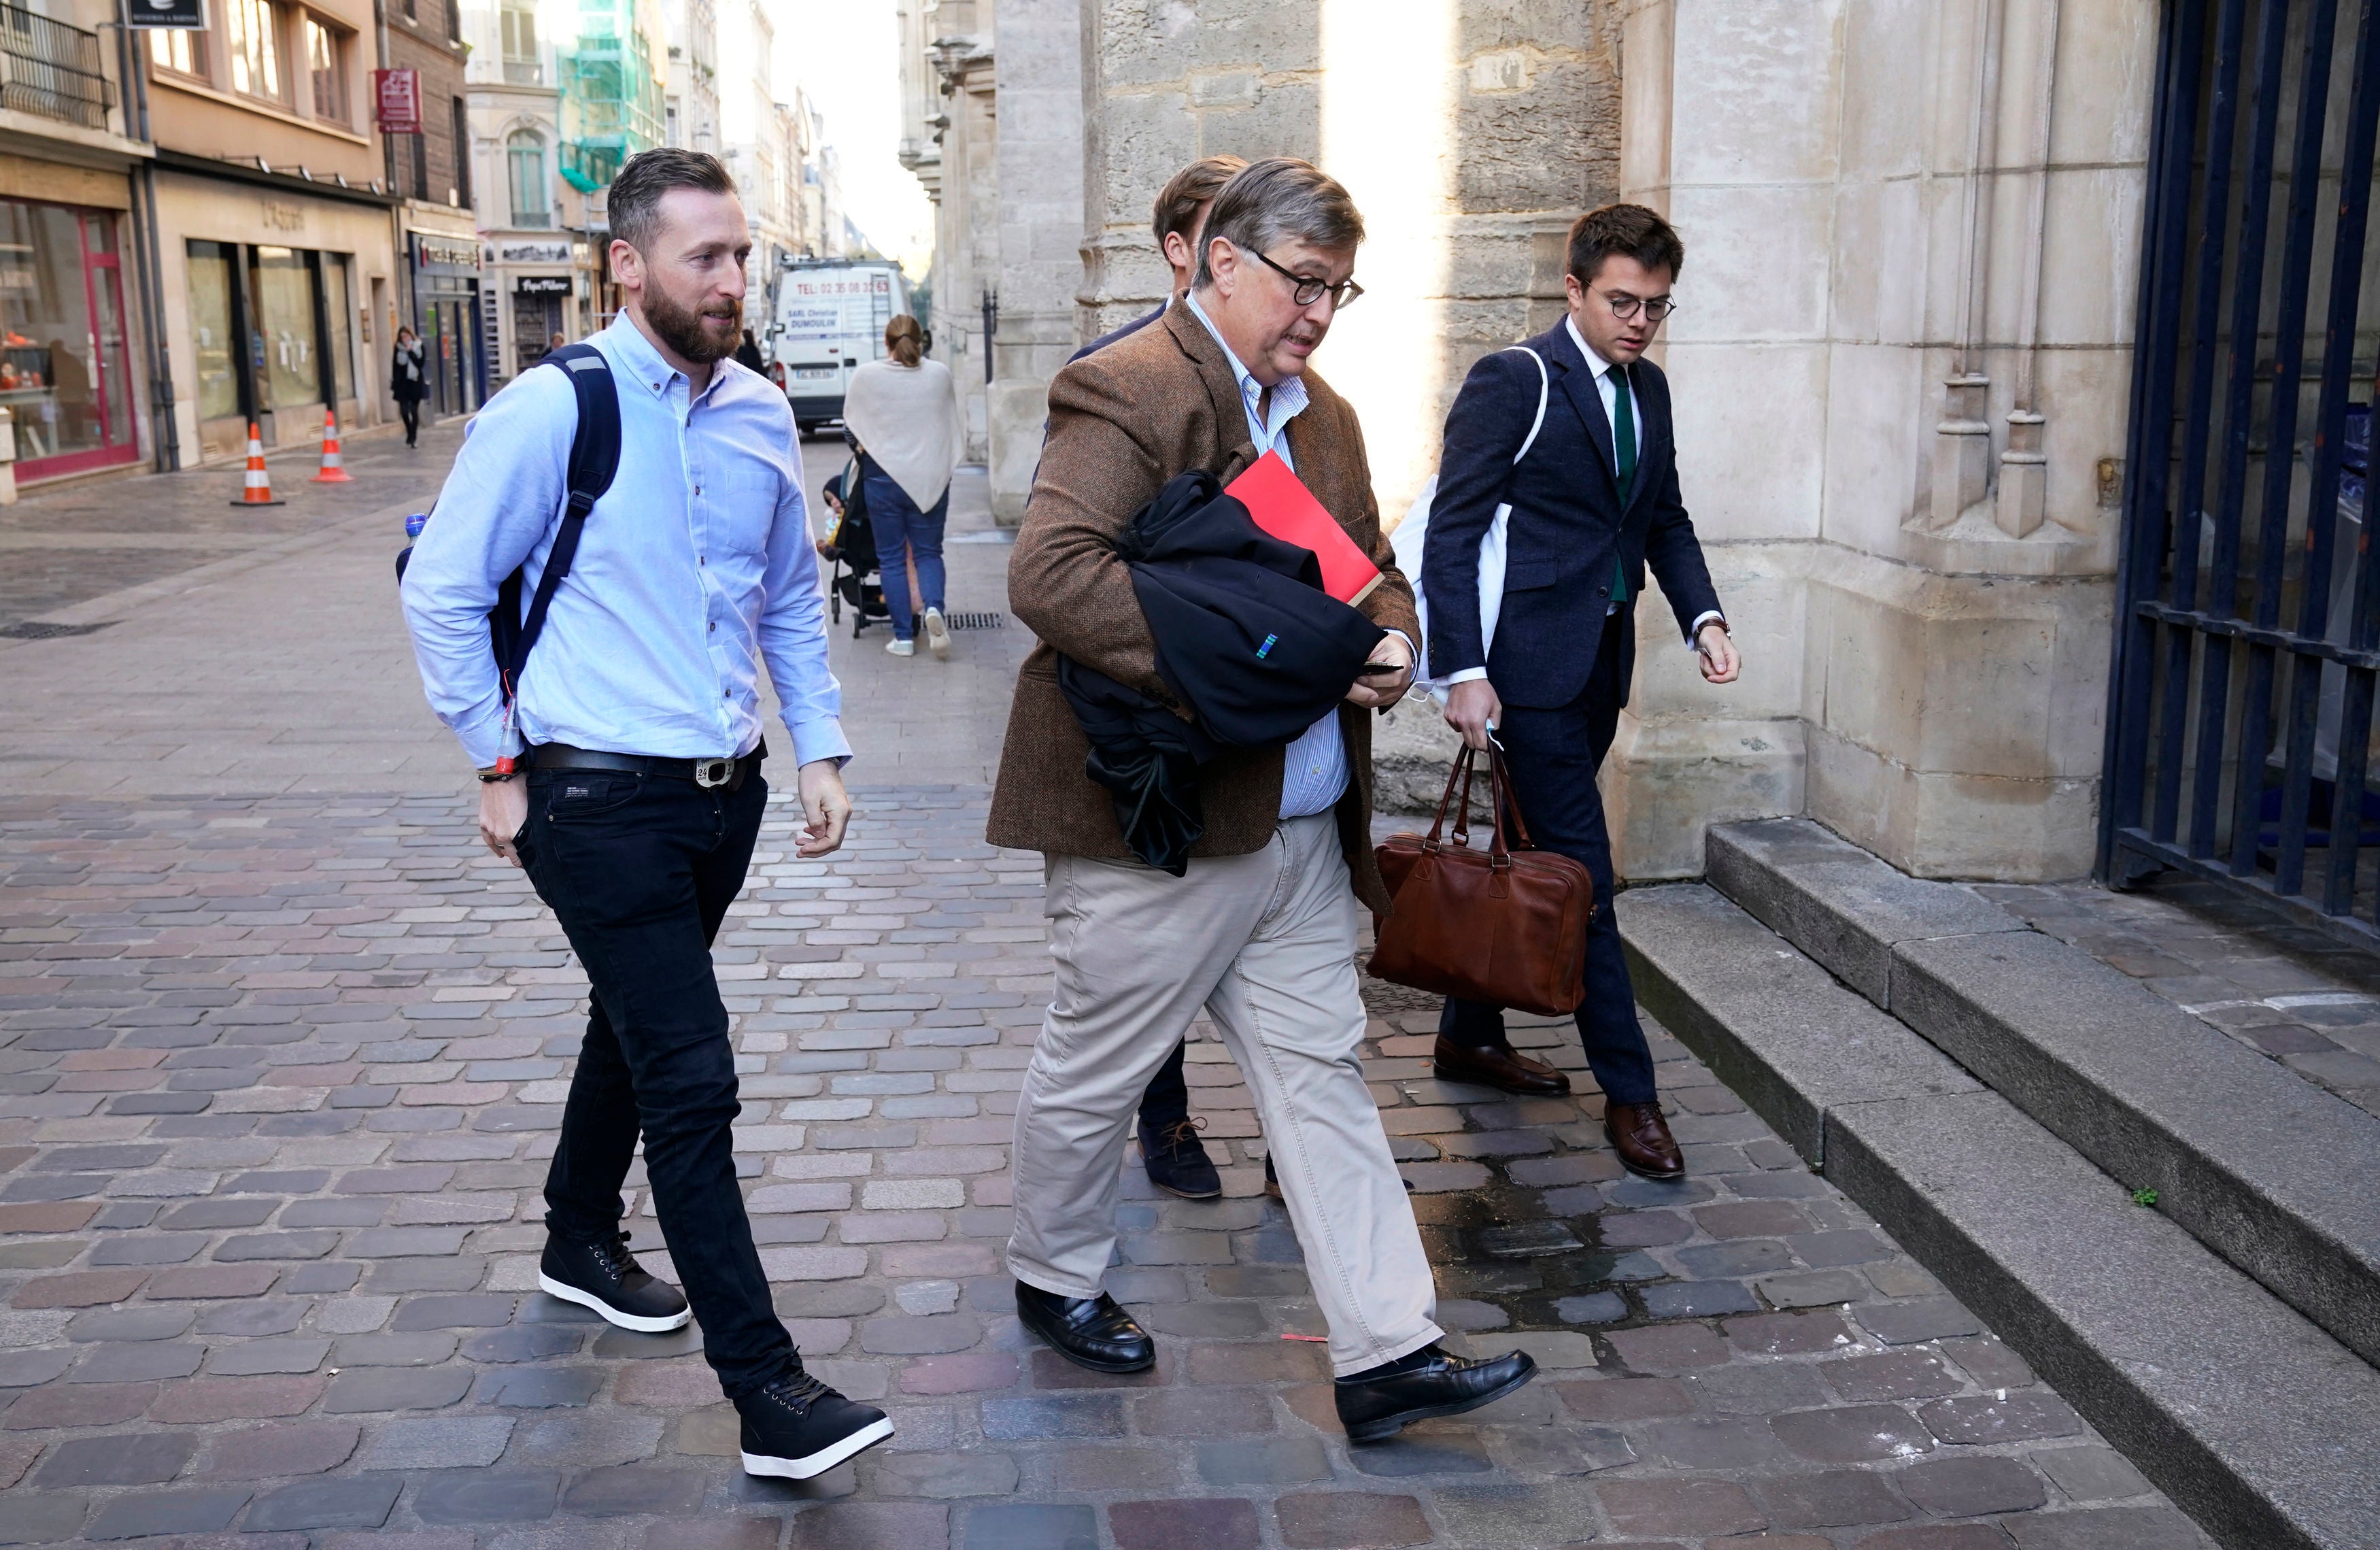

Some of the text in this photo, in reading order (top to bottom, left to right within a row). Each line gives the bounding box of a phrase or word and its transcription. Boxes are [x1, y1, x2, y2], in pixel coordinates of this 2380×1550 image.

[798, 284, 818, 294] TEL:
[821, 283, 832, 294] 02
[792, 320, 836, 328] DUMOULIN
[698, 769, 707, 777] 24
